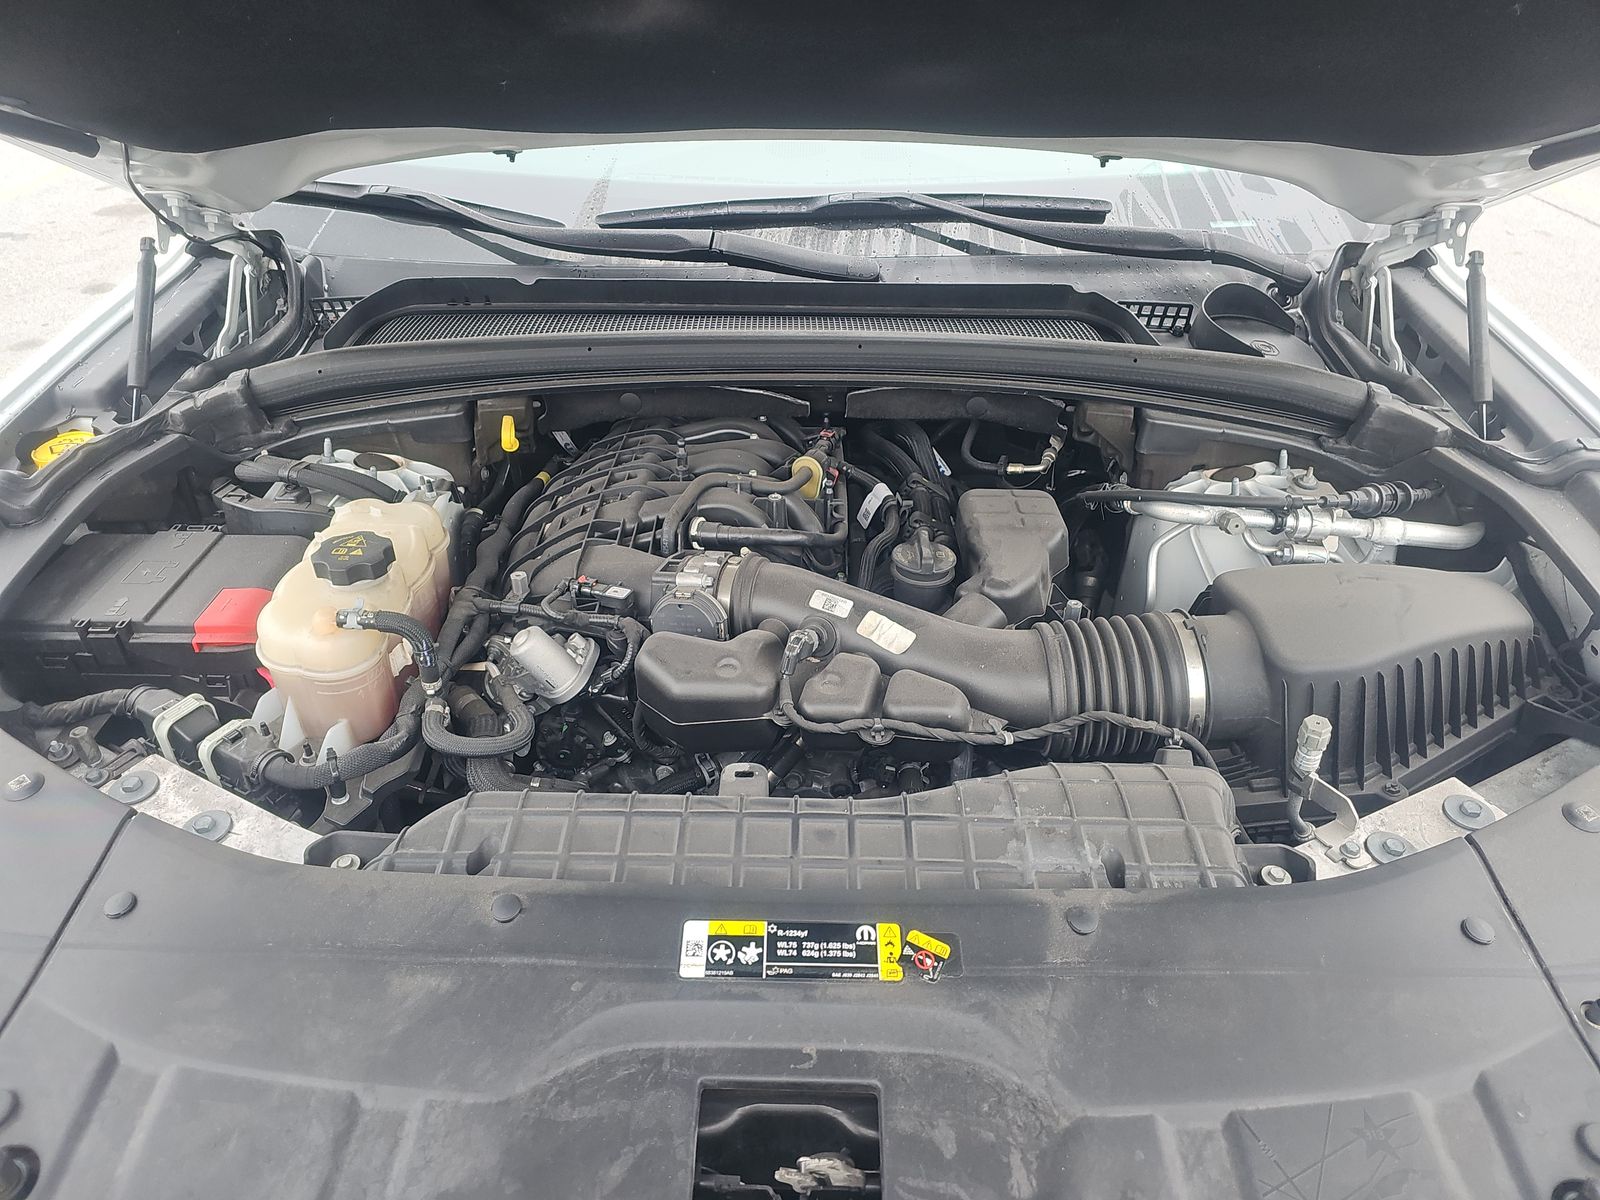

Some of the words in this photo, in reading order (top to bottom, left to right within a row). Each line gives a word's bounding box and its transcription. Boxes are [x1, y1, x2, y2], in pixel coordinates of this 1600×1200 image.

[777, 929, 809, 938] R-1234yf
[776, 941, 798, 949] WL75
[801, 942, 820, 950] 737g
[820, 942, 841, 950] (1.625
[841, 942, 856, 950] lbs)
[776, 949, 798, 957] WL74
[801, 950, 820, 958] 624g
[820, 950, 841, 958] (1.375
[842, 950, 857, 959] lbs)
[779, 967, 794, 975] PAG
